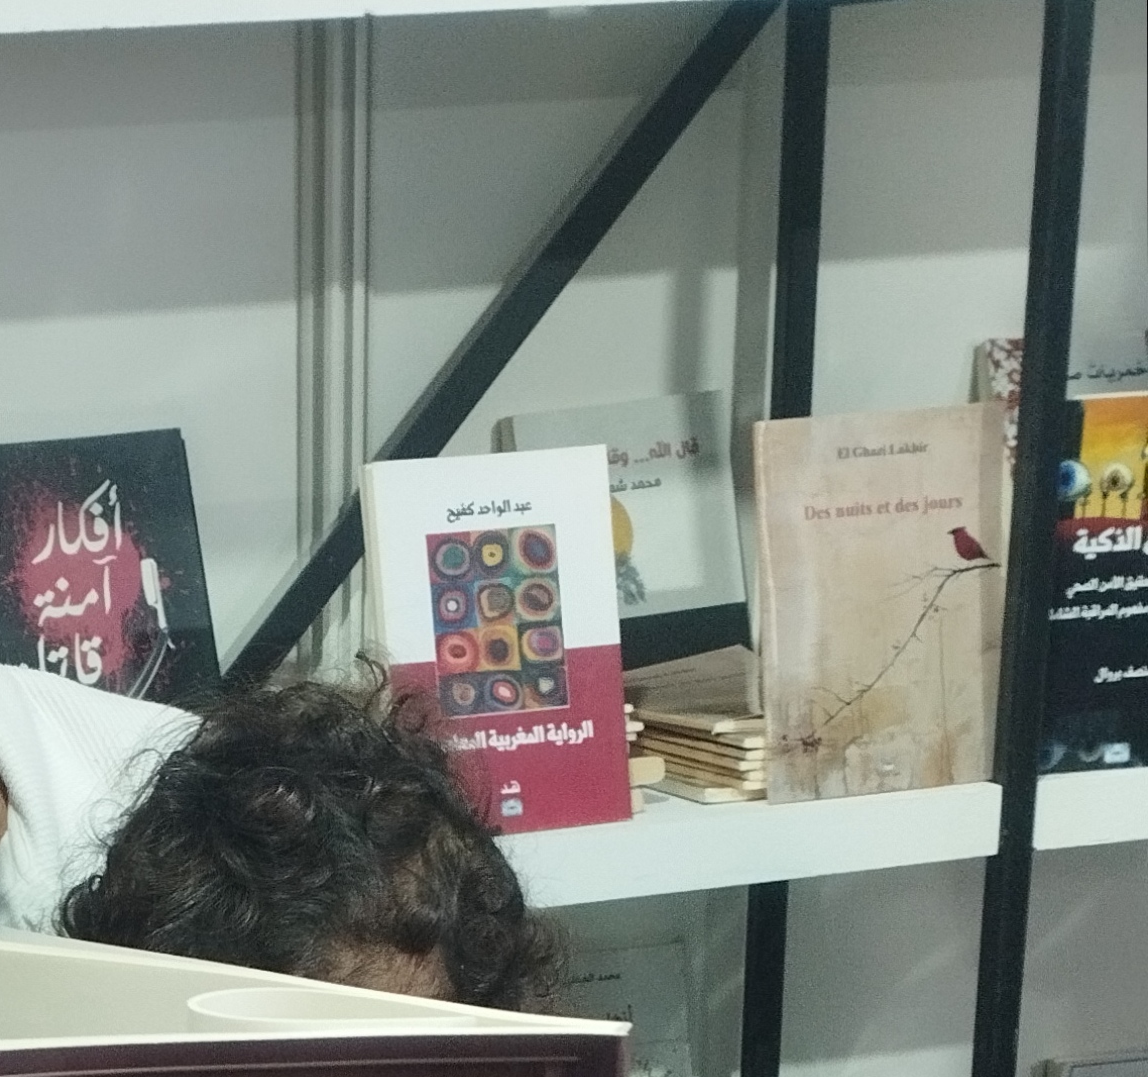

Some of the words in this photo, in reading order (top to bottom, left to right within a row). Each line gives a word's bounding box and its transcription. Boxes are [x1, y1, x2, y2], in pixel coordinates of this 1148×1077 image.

[630, 478, 662, 490] محمد
[478, 500, 511, 517] الواحد
[513, 502, 532, 515] عبد
[804, 505, 831, 521] Des
[835, 502, 873, 518] nuits
[877, 501, 890, 515] et
[895, 498, 919, 513] des
[922, 496, 964, 515] jours
[31, 479, 121, 565] أفكار
[1073, 525, 1143, 560] الذكية
[34, 554, 118, 627] آمنة
[488, 725, 545, 751] المغربية
[546, 719, 594, 746] الرواية
